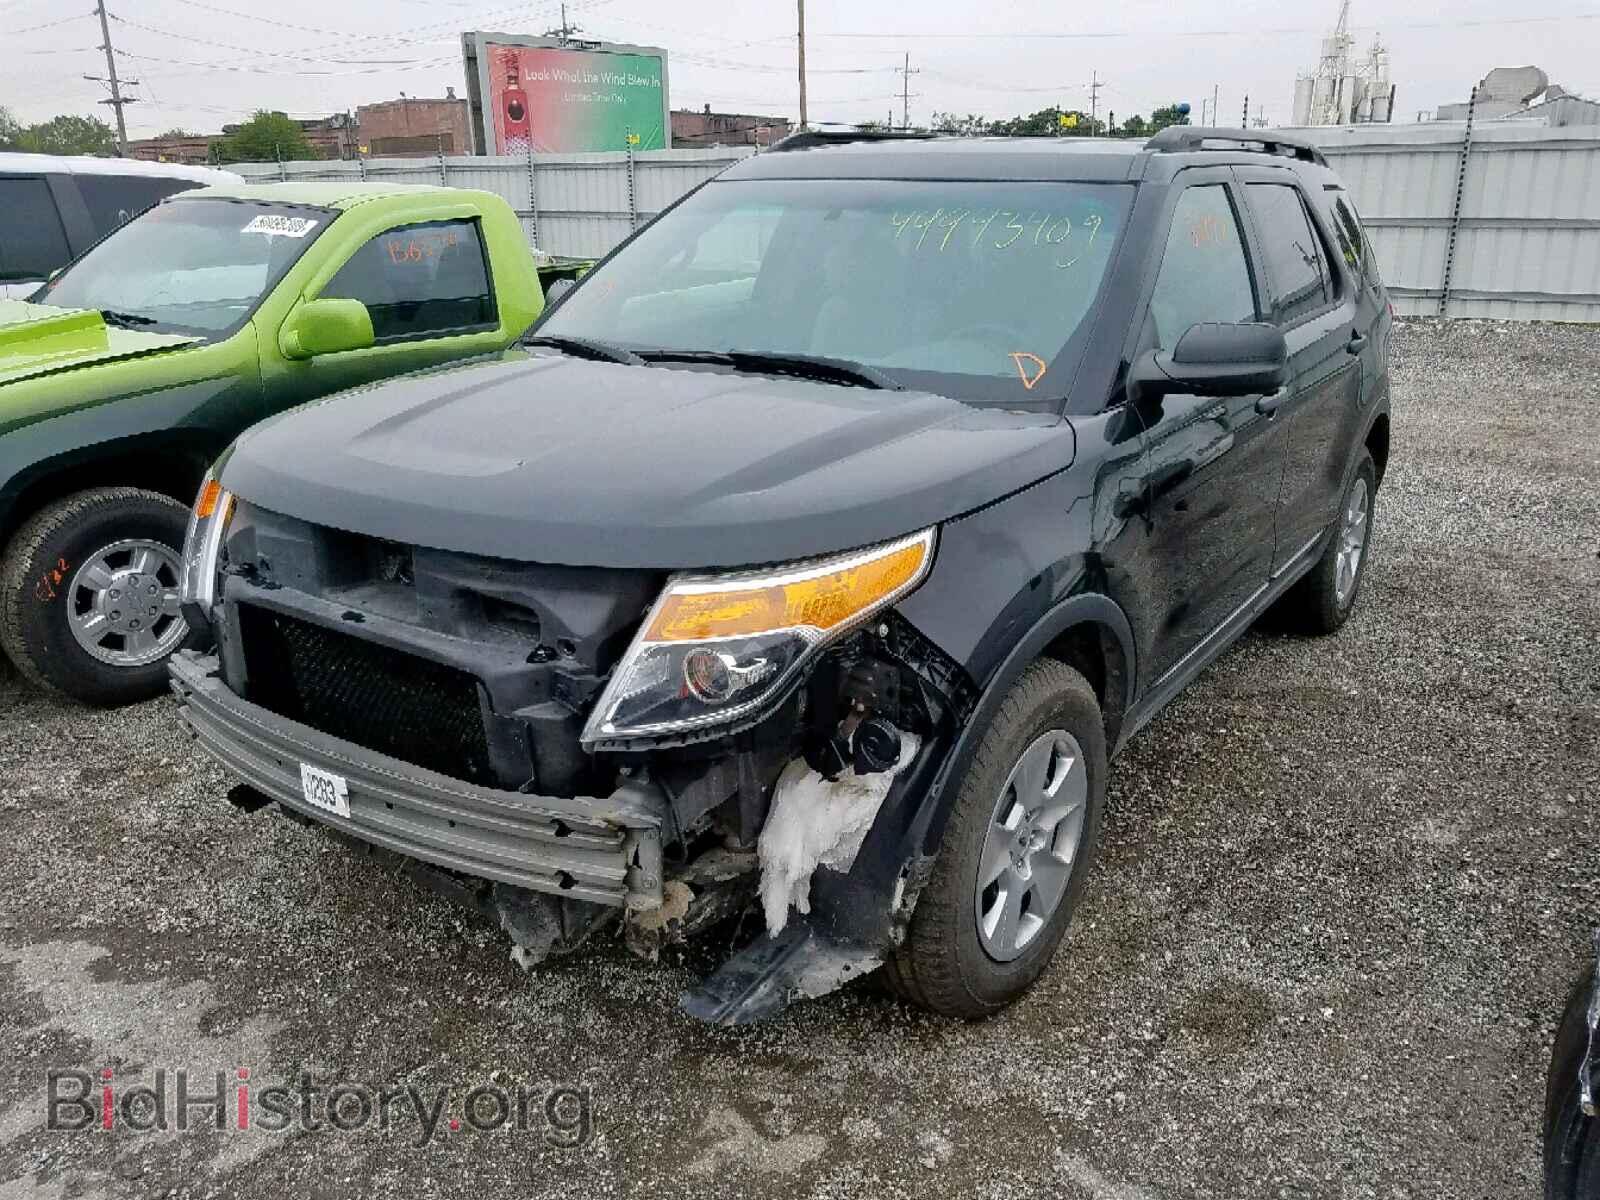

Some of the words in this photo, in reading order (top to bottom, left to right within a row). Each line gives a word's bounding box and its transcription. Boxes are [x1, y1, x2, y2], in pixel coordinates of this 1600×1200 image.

[524, 67, 550, 81] Look
[552, 69, 582, 83] What
[583, 69, 599, 84] the
[600, 72, 627, 87] Wind
[627, 73, 650, 87] Blew
[1008, 352, 1047, 389] D
